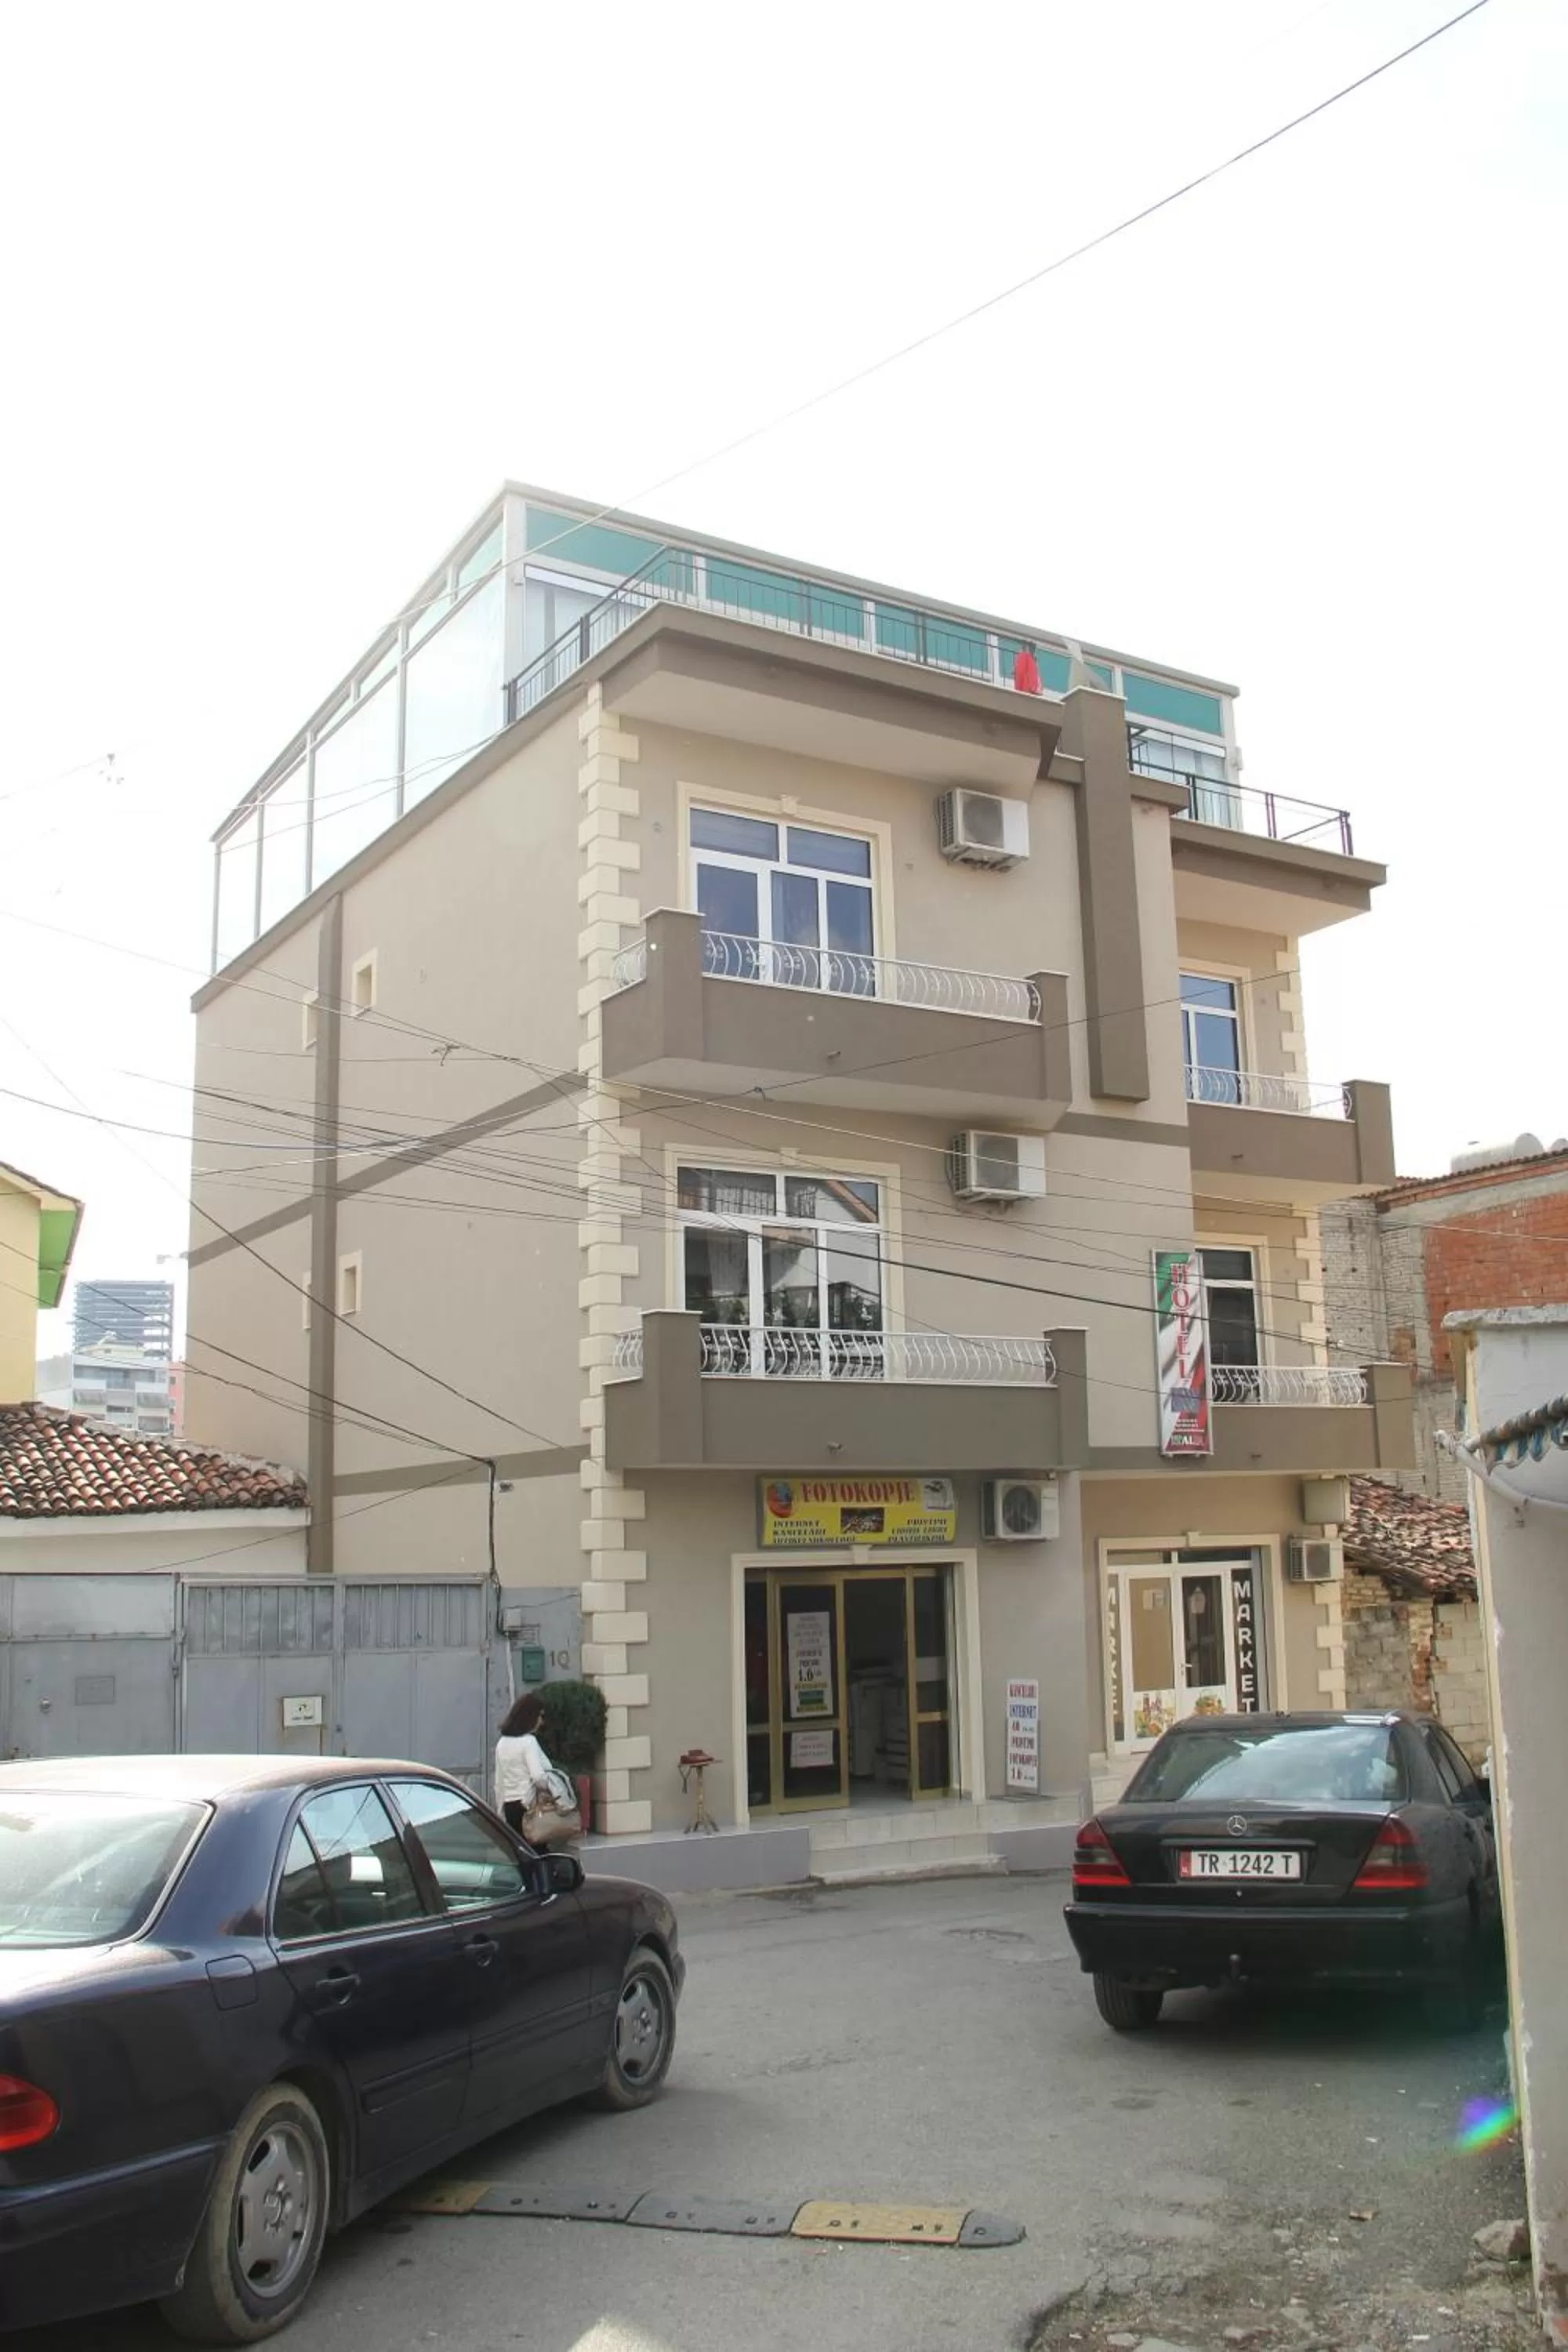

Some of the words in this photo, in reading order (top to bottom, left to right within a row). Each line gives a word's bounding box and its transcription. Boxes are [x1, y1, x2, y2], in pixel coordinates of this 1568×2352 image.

[1171, 1263, 1190, 1380] HOTEL
[800, 1481, 915, 1504] FOTOKOPJE
[1233, 1579, 1254, 1712] MARKET
[1197, 1853, 1219, 1874] TR
[1228, 1854, 1274, 1875] 1242
[1281, 1854, 1293, 1874] T
